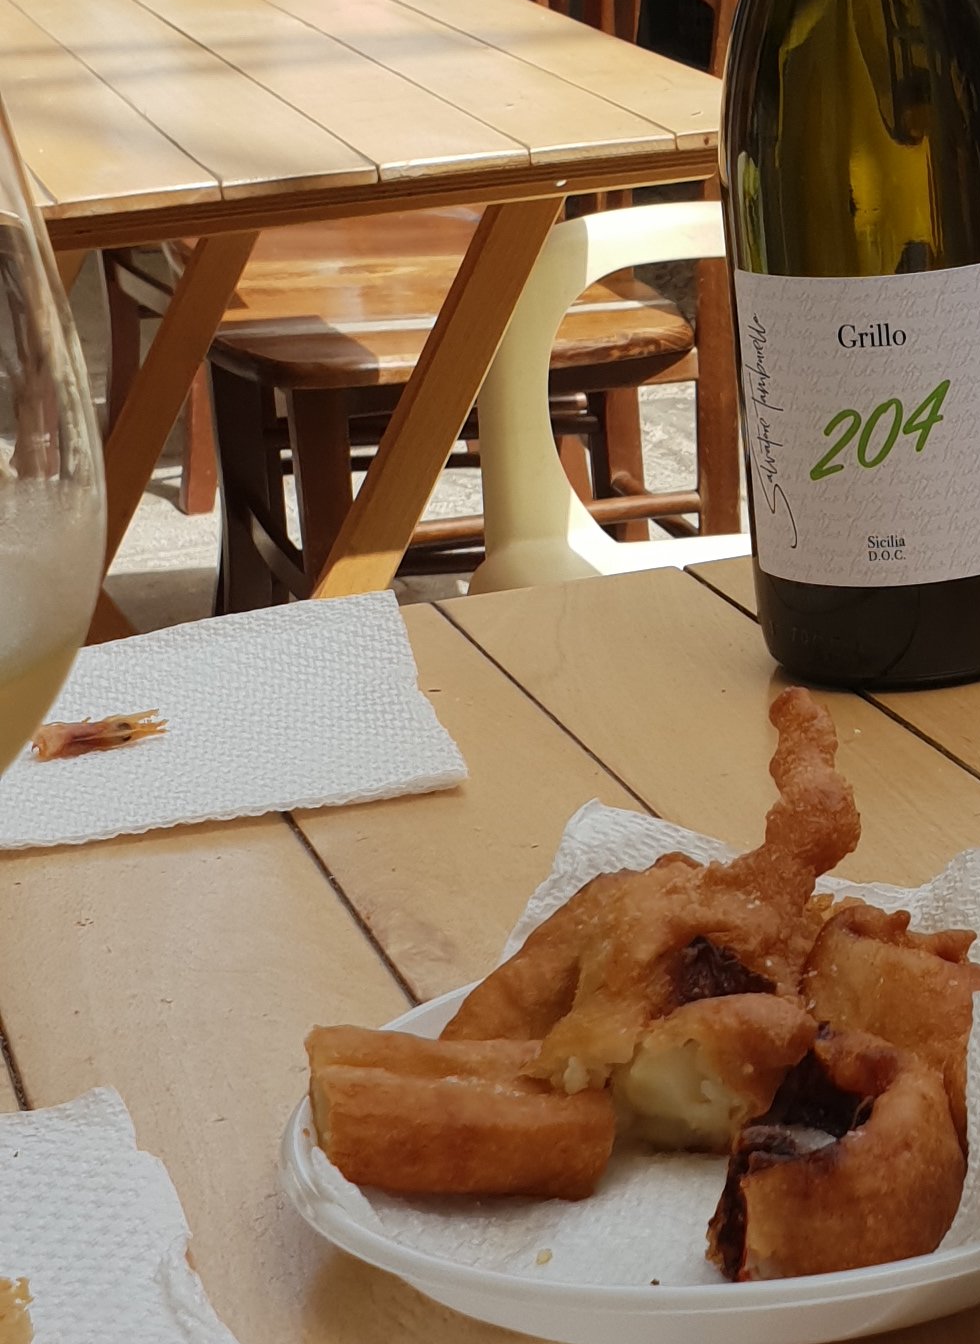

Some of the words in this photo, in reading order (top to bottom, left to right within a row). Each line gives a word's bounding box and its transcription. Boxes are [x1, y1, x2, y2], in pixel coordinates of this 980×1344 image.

[837, 323, 907, 349] Grillo
[809, 379, 951, 481] 204
[867, 534, 907, 549] Sicilia
[868, 549, 907, 562] D.O.C.
